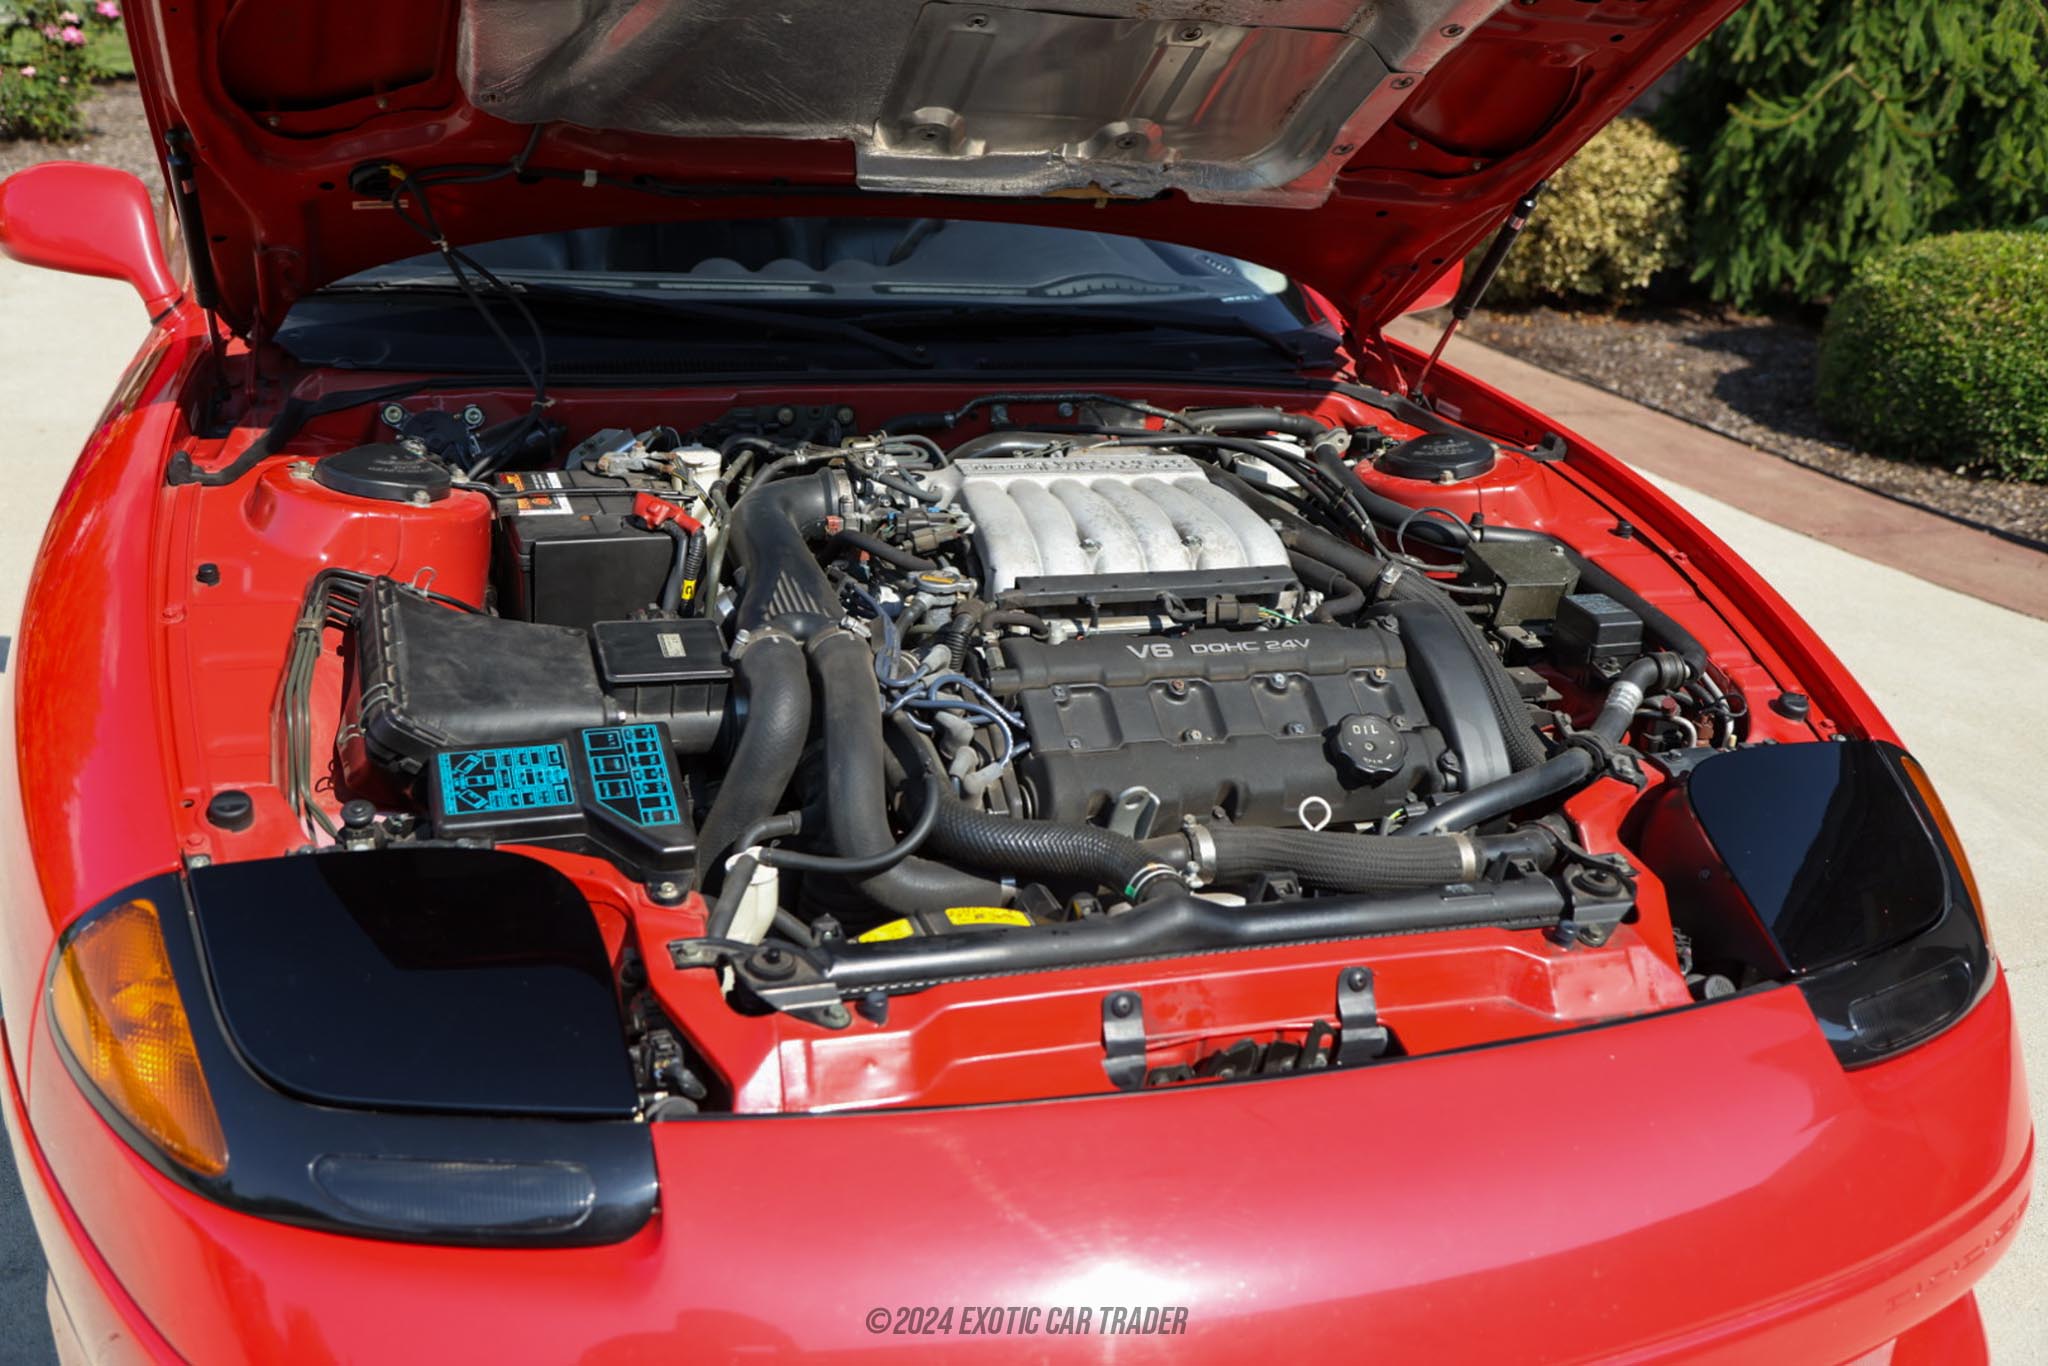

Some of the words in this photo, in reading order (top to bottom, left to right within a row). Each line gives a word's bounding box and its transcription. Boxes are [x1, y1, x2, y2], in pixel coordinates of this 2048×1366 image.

[1126, 642, 1175, 660] V6
[1190, 641, 1260, 655] DOHC
[1264, 638, 1311, 652] 24V
[1352, 724, 1380, 735] OIL
